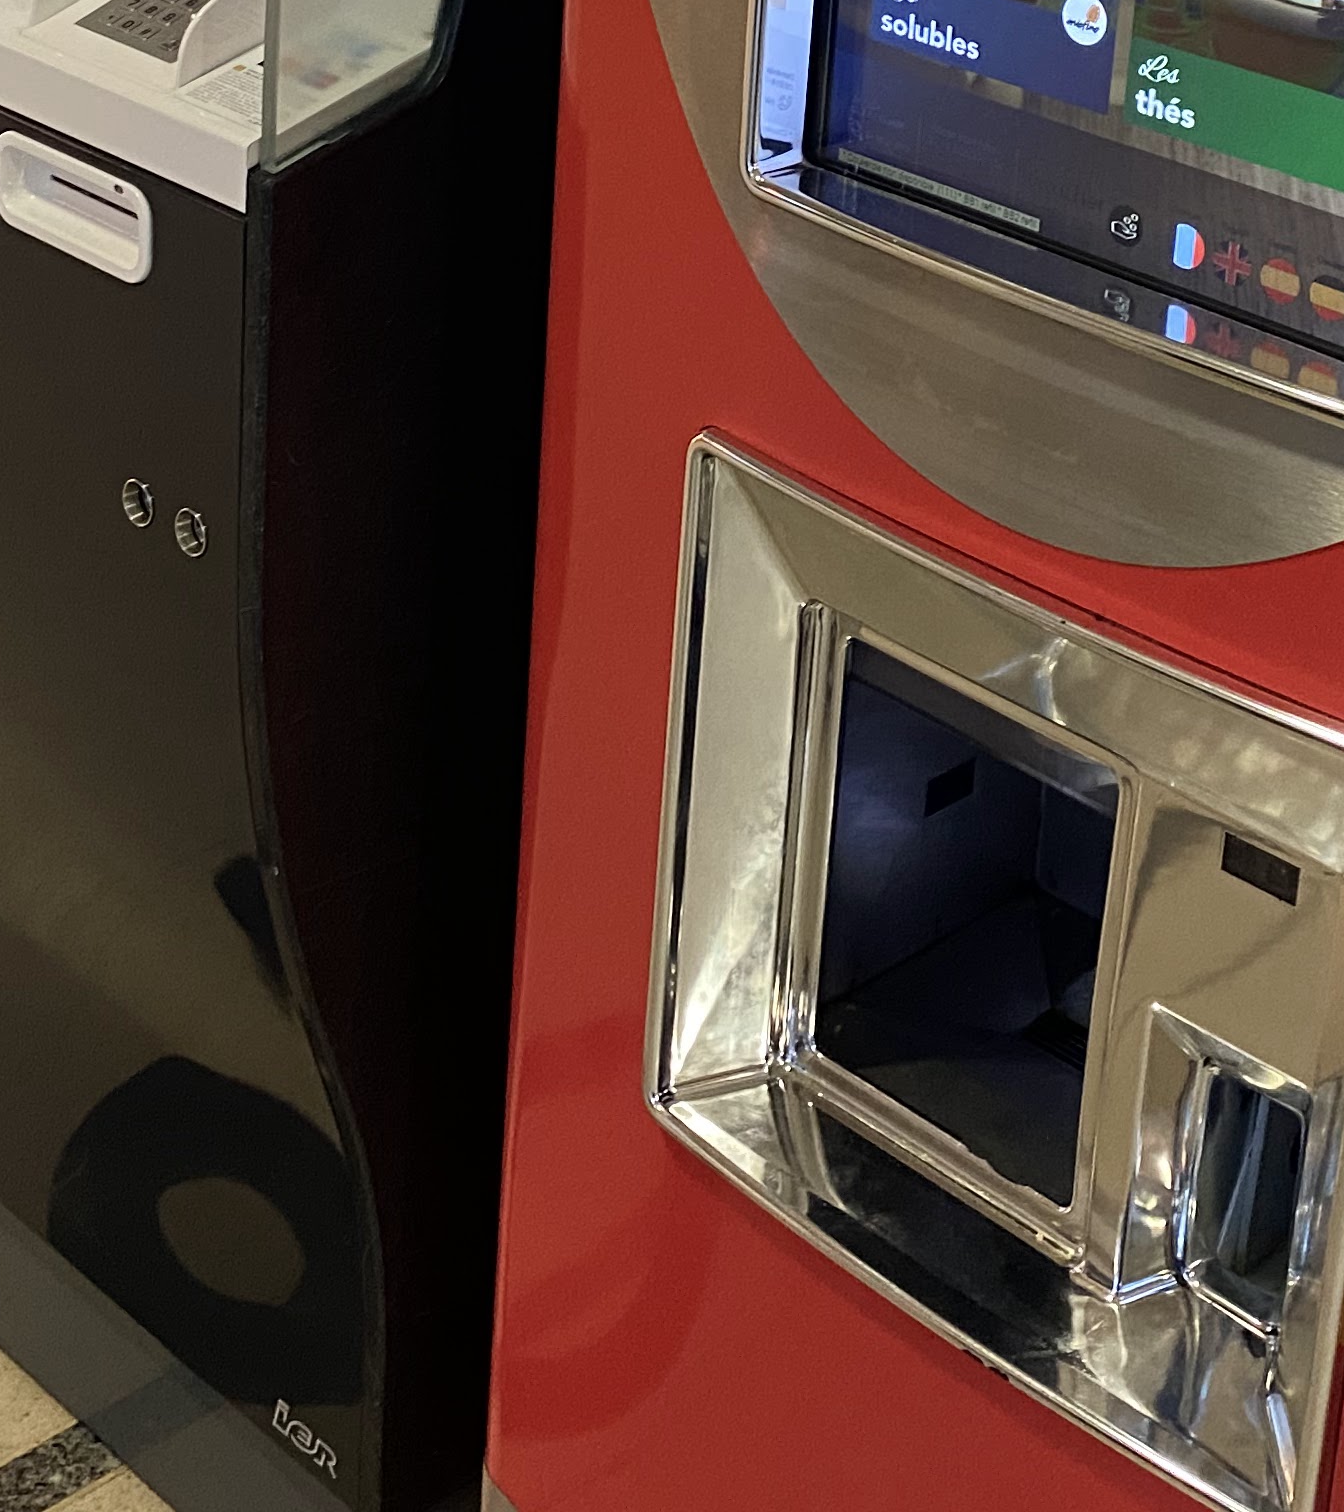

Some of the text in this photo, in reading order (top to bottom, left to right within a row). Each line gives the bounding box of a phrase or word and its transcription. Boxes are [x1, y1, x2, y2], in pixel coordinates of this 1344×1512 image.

[880, 11, 980, 61] solubles
[1138, 55, 1180, 84] Les
[1135, 88, 1196, 130] thés
